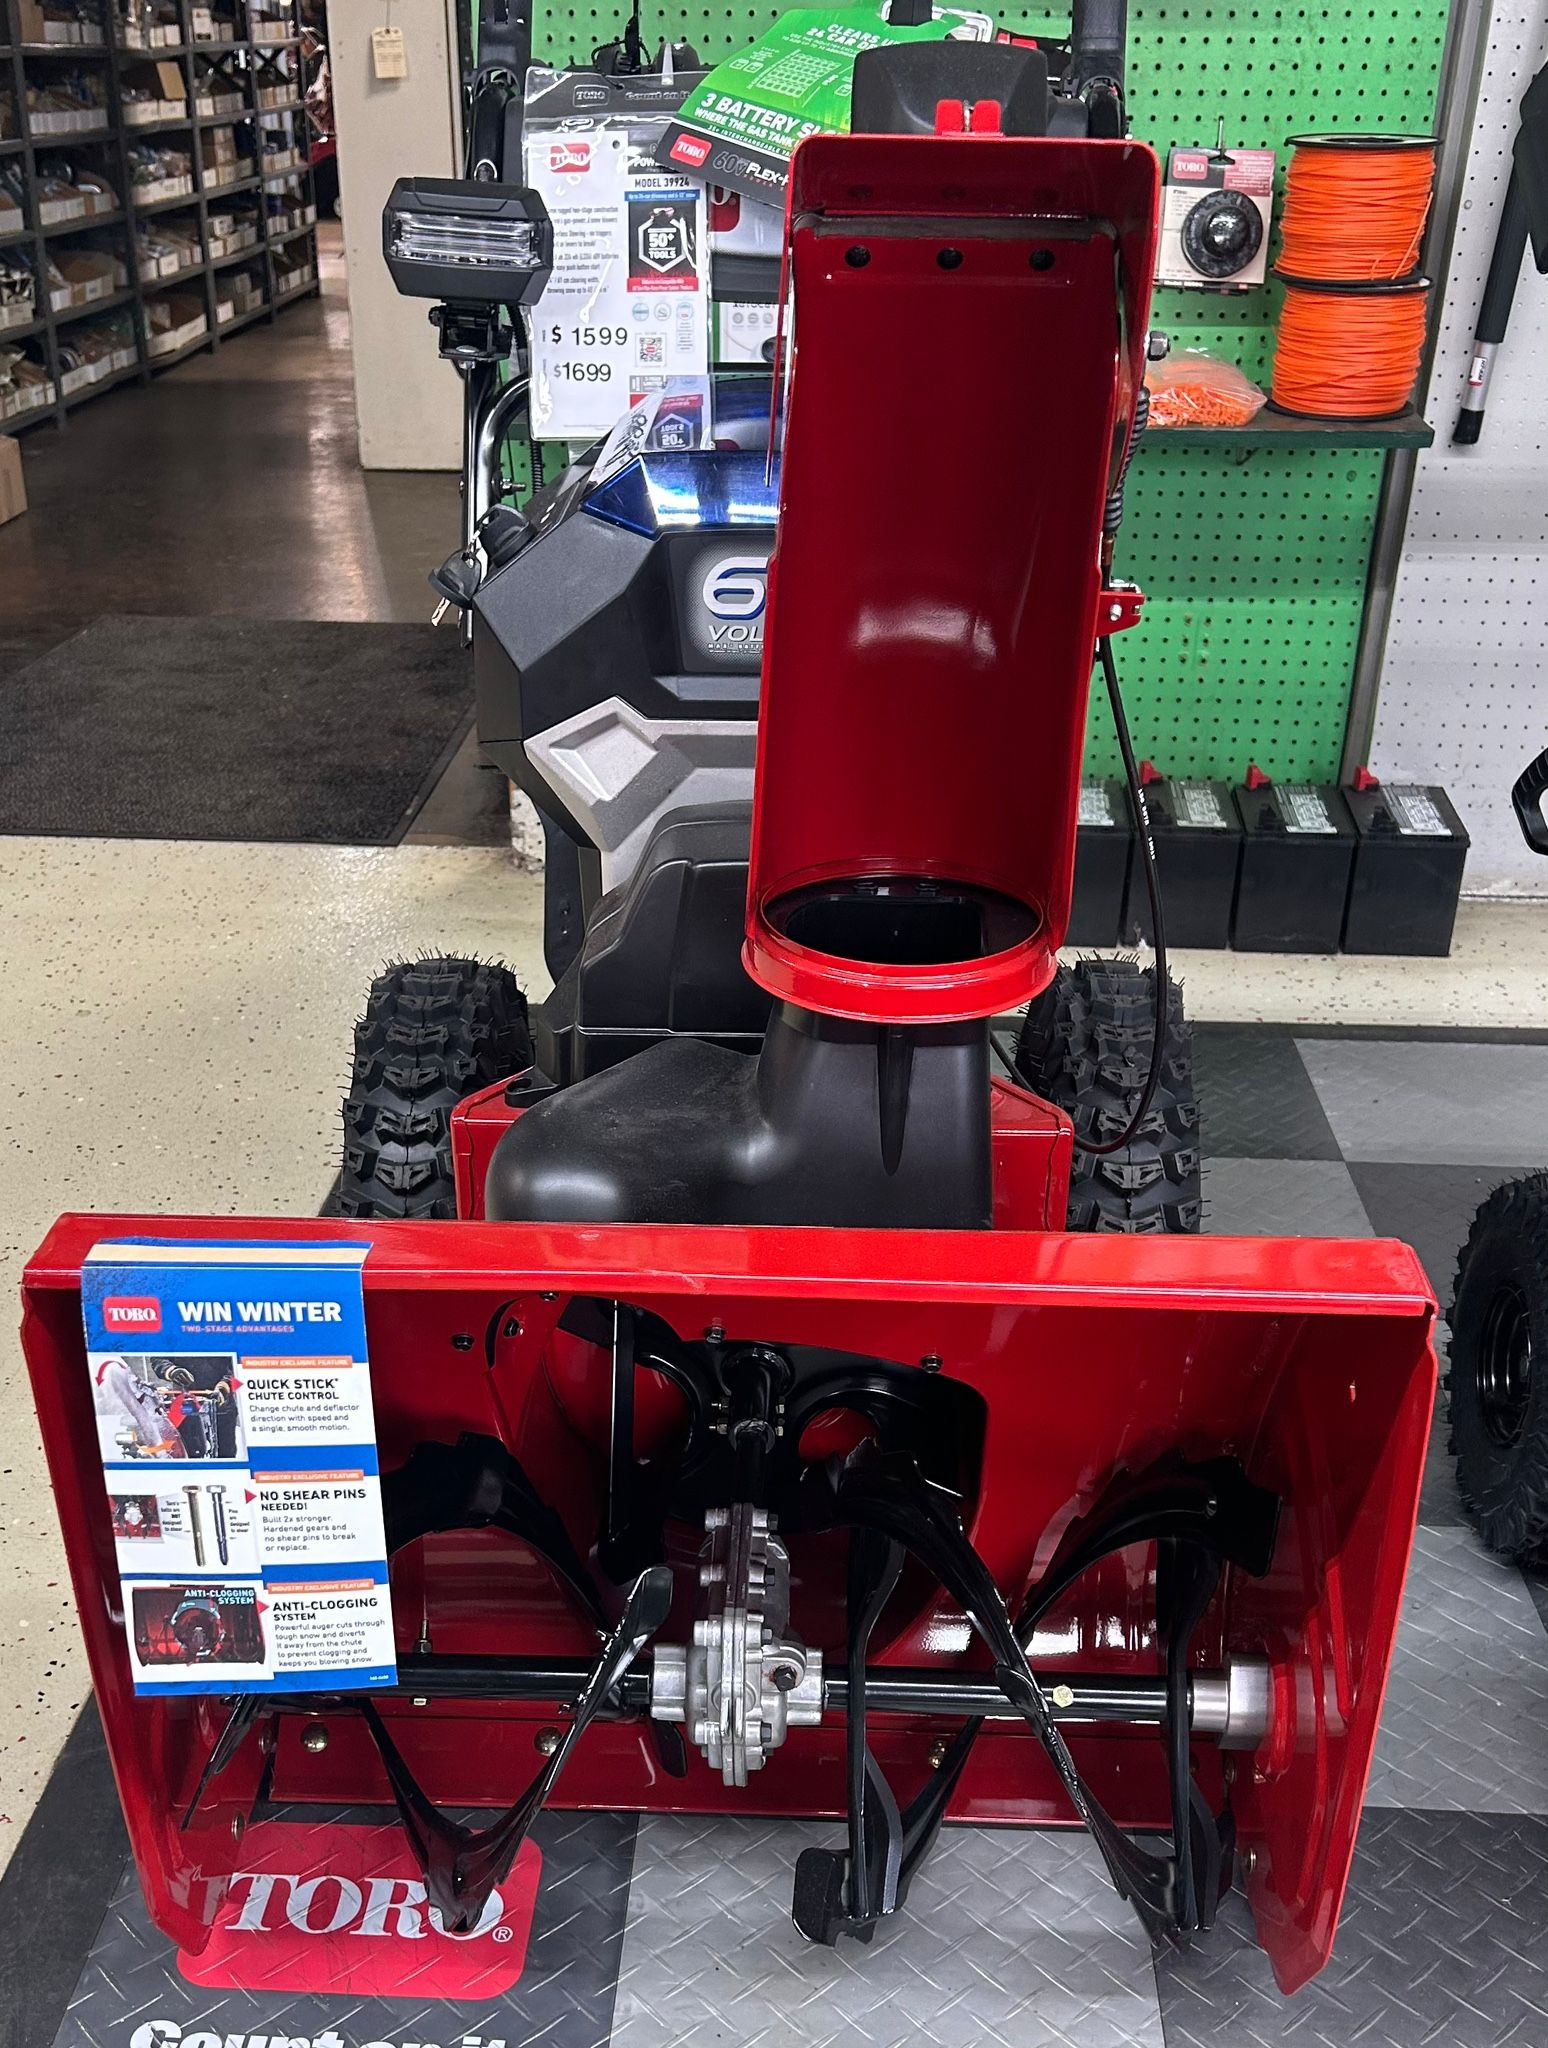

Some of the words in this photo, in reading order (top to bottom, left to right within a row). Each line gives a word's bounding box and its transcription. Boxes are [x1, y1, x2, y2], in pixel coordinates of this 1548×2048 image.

[827, 33, 856, 46] CAR
[828, 24, 880, 43] CLEARS
[701, 92, 717, 108] 3
[714, 96, 801, 134] BATTERY
[695, 107, 729, 126] WHERE
[728, 117, 749, 132] THE
[747, 125, 768, 138] GAS
[768, 131, 796, 147] TANK
[677, 141, 707, 158] TORO
[1177, 161, 1205, 172] TORO
[634, 177, 662, 188] MODEL
[664, 177, 690, 188] 39924
[648, 232, 675, 248] 50+
[648, 250, 676, 259] TOOLS
[551, 324, 562, 344] $
[571, 326, 628, 346] 1599
[553, 360, 611, 382] $1699
[702, 556, 768, 620] 6
[708, 625, 764, 642] VOL
[108, 1307, 158, 1322] TORO
[177, 1301, 232, 1322] WIN
[236, 1301, 342, 1322] WINTER
[181, 1325, 233, 1333] TWO-STAGE
[236, 1325, 295, 1333] ADVANTAGES
[247, 1378, 289, 1390] QUICK
[248, 1392, 285, 1400] CHUTE
[288, 1391, 340, 1400] CONTROL
[249, 1405, 279, 1413] Change
[308, 1415, 332, 1423] speed
[260, 1491, 279, 1501] NO
[283, 1490, 330, 1501] SHEAR
[334, 1489, 367, 1499] PINS
[261, 1502, 307, 1511] NEEDED!
[306, 1525, 330, 1533] gears
[303, 1534, 320, 1542] pins
[332, 1532, 356, 1540] break
[184, 1589, 255, 1597] ANTI-CLOGGING
[272, 1598, 378, 1612] ANTI-CLOGGING
[273, 1613, 316, 1621] SYSTEM
[311, 1623, 334, 1631] auger
[354, 1619, 386, 1627] through
[275, 1633, 298, 1641] tough
[284, 1642, 304, 1650] away
[319, 1658, 350, 1666] blowing
